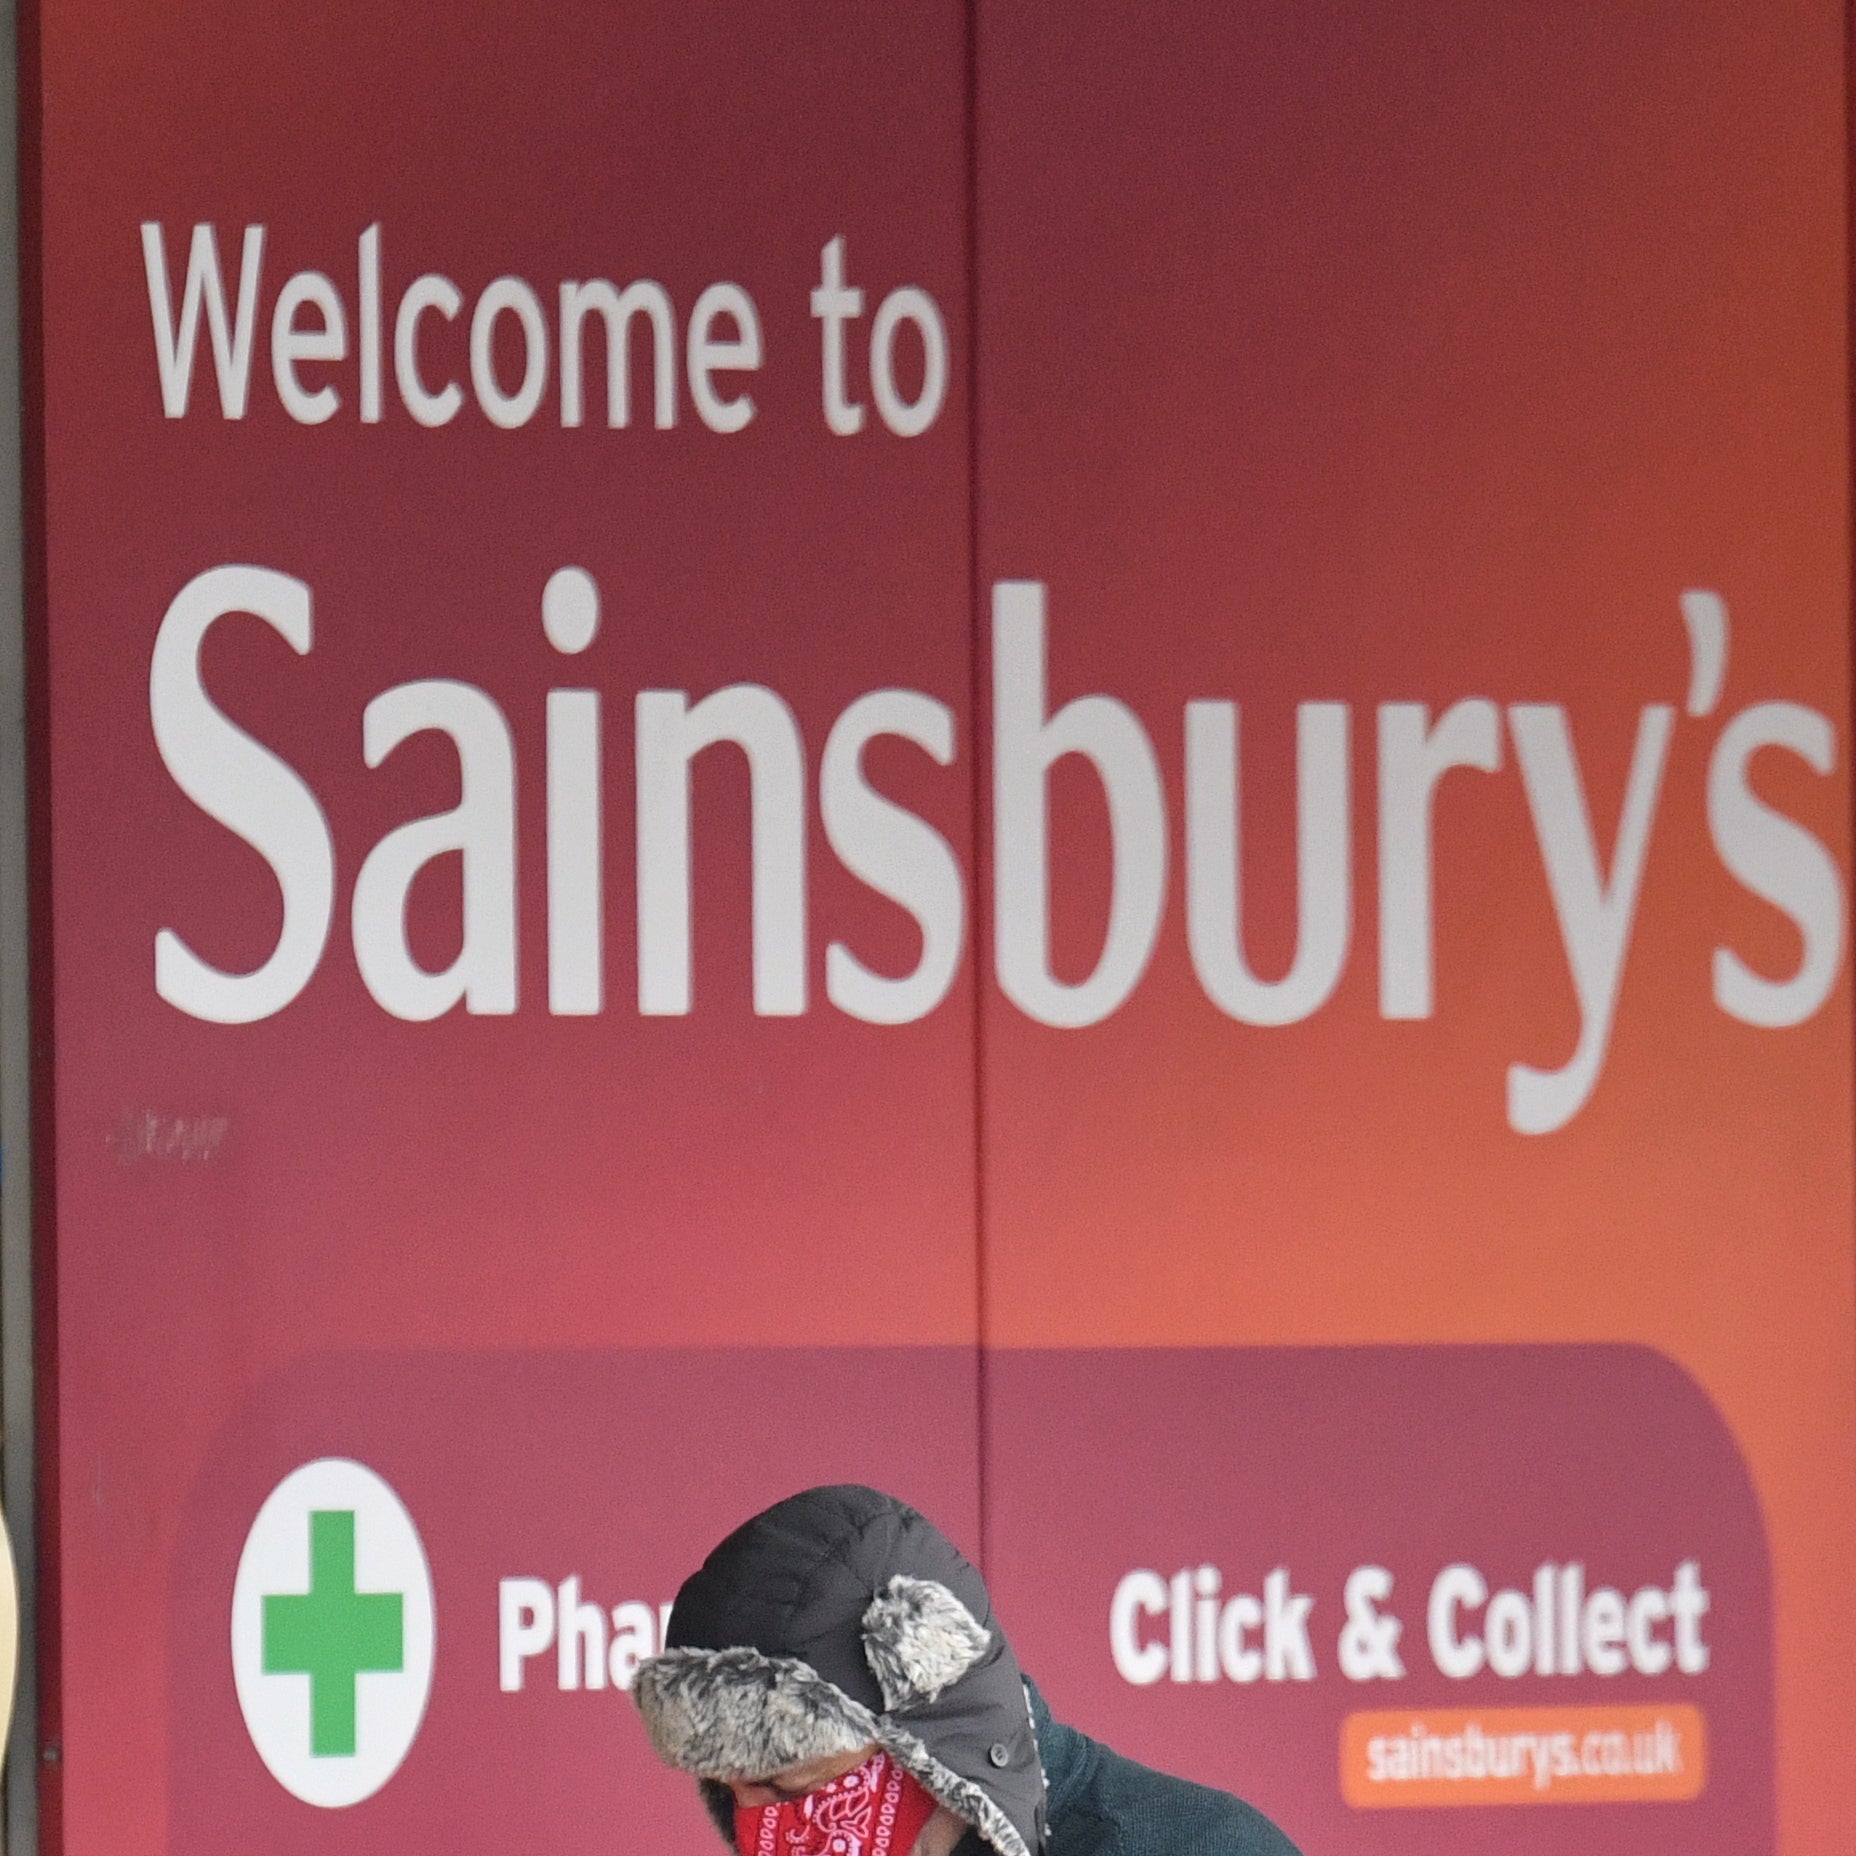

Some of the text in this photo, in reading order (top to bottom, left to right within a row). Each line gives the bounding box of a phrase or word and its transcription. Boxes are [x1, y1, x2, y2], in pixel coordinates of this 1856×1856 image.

[141, 222, 948, 437] Welcome to
[149, 563, 1846, 1135] Sainsbury's
[1109, 1558, 1710, 1685] Click & Collect
[1367, 1720, 1684, 1791] sainsburys.co.uk
